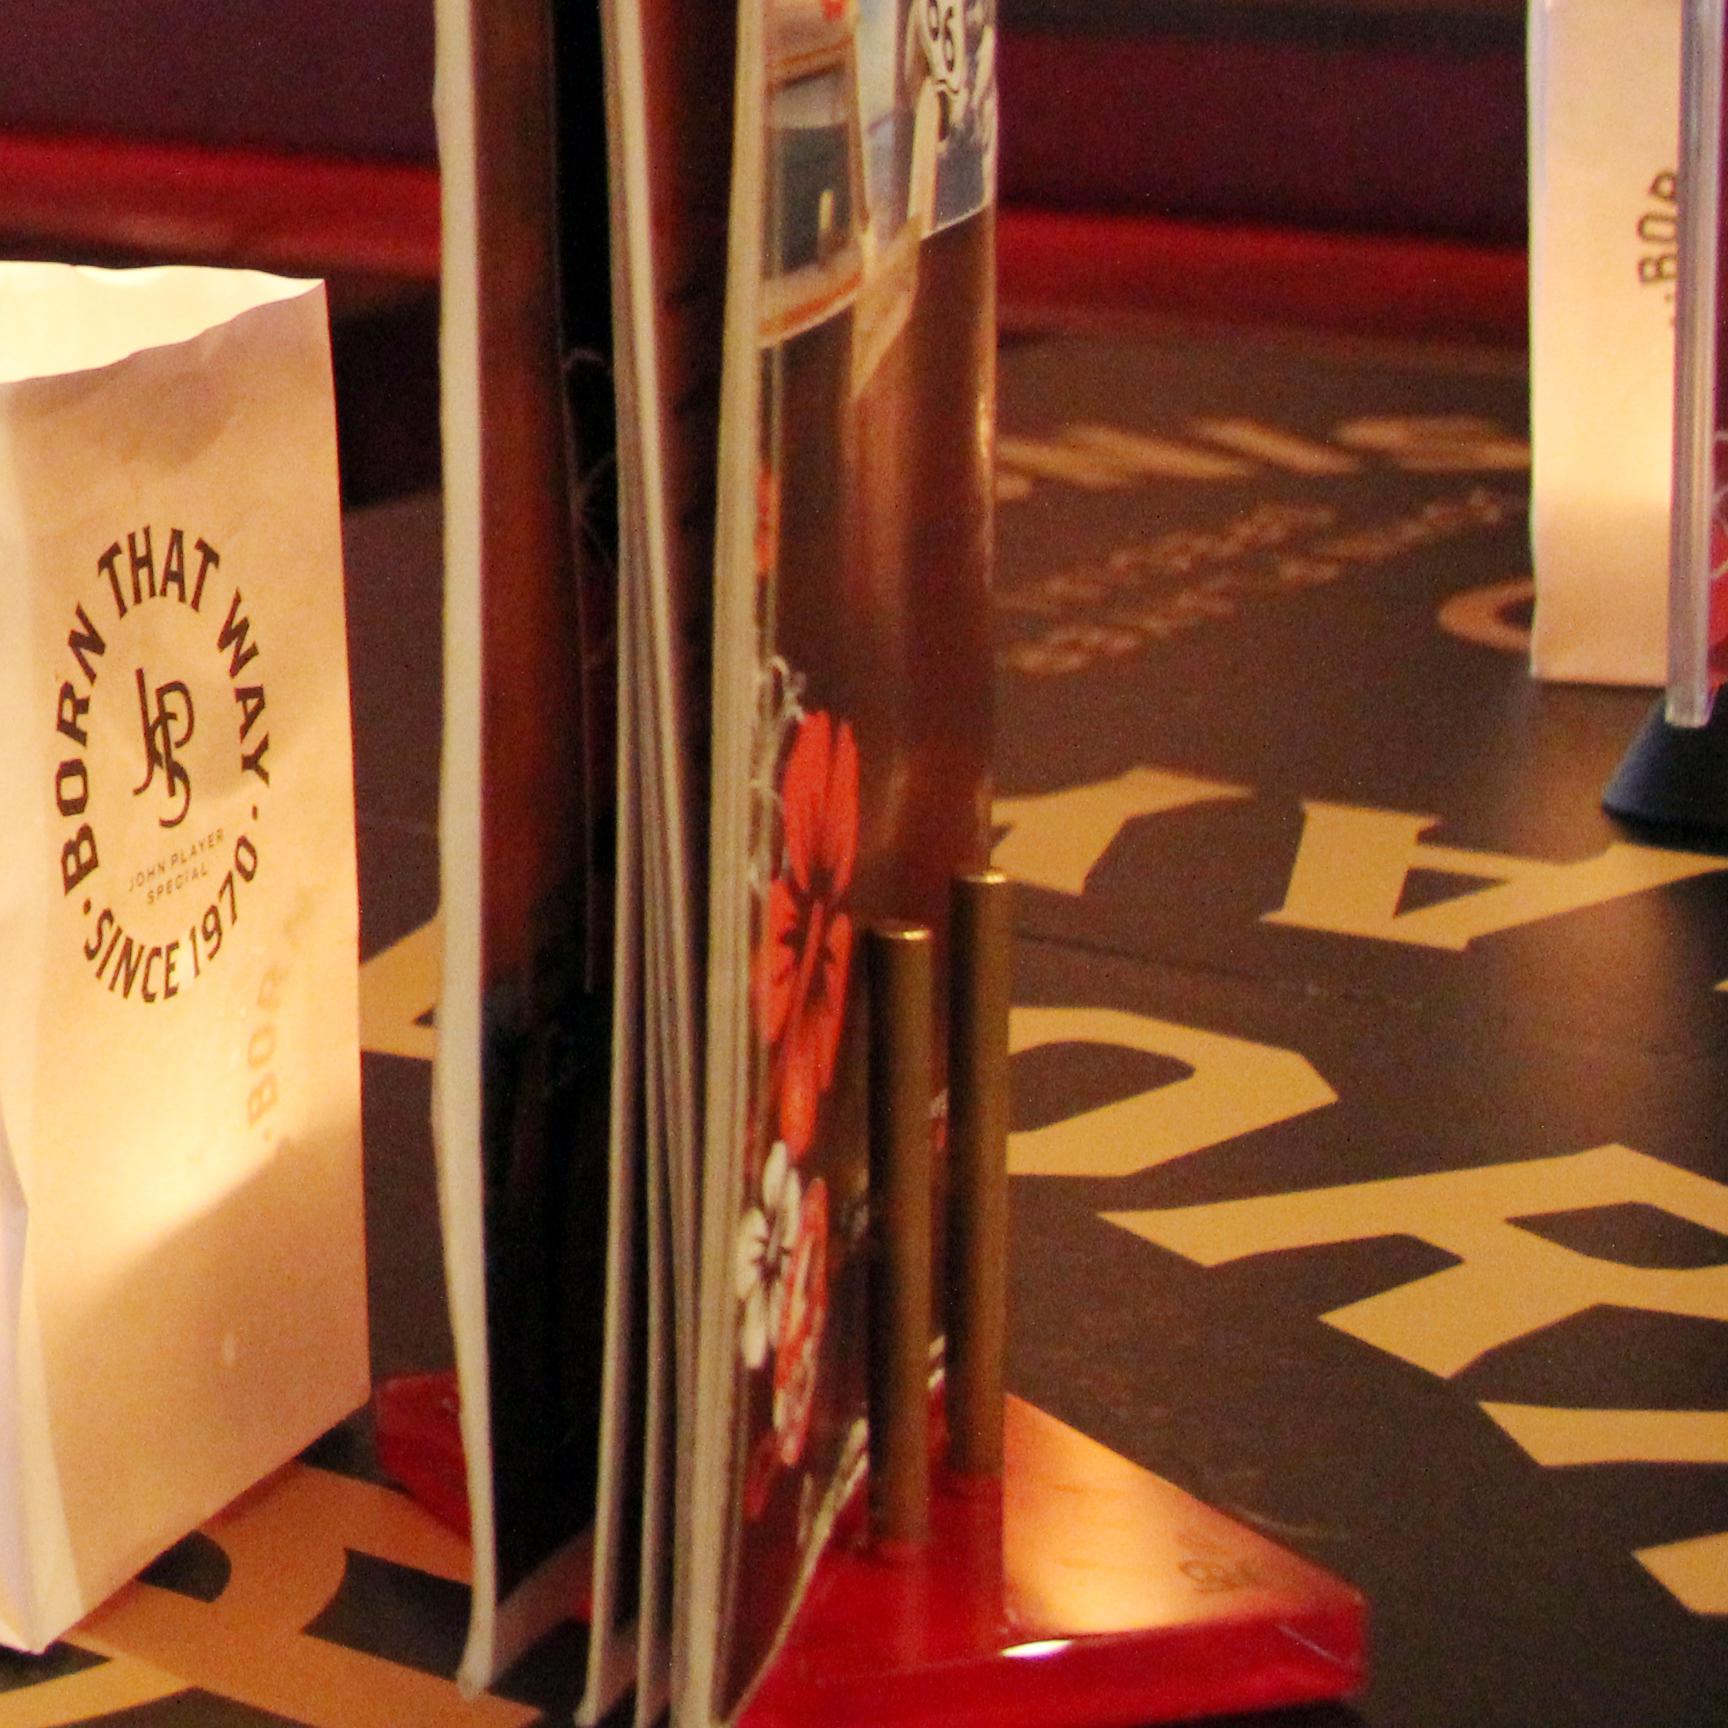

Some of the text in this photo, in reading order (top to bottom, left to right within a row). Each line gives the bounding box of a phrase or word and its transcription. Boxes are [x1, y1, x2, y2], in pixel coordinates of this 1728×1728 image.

[55, 525, 271, 896] BORN THAT WAY
[128, 828, 224, 893] JOHN PLAYER
[146, 862, 209, 905] SPECIAL
[83, 835, 259, 1004] SINCE 1970
